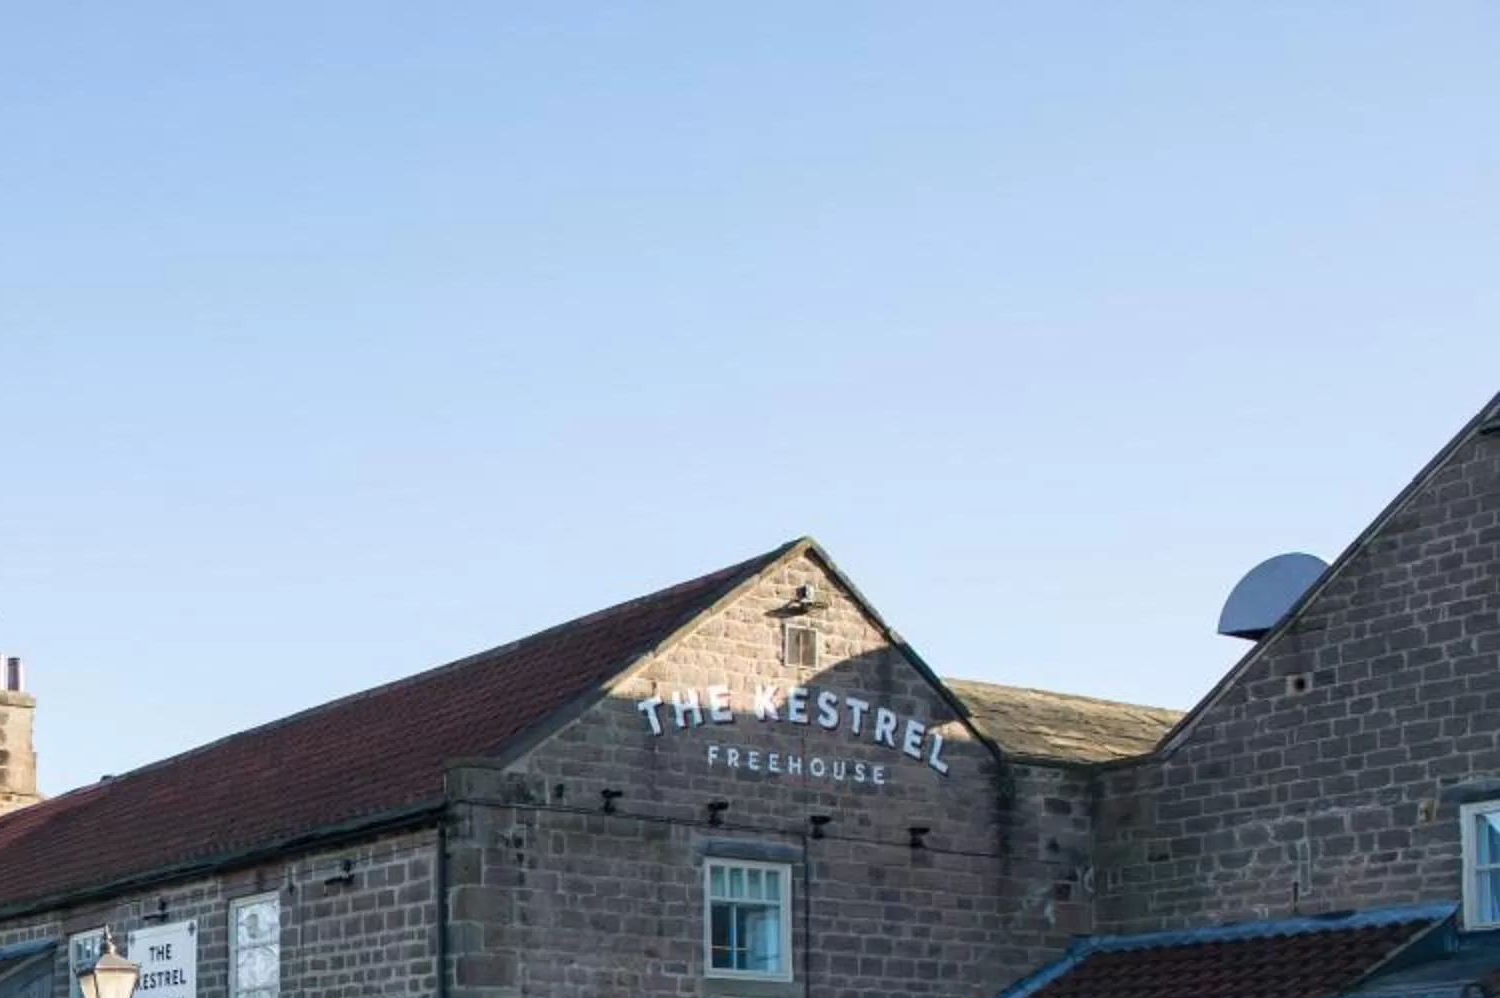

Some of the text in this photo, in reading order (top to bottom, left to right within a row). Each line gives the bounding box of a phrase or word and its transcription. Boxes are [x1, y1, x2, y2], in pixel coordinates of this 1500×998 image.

[638, 683, 950, 776] THE KESTREL
[706, 745, 886, 785] FREEHOUSE
[149, 943, 172, 962] THE
[137, 968, 187, 990] ESTREL
